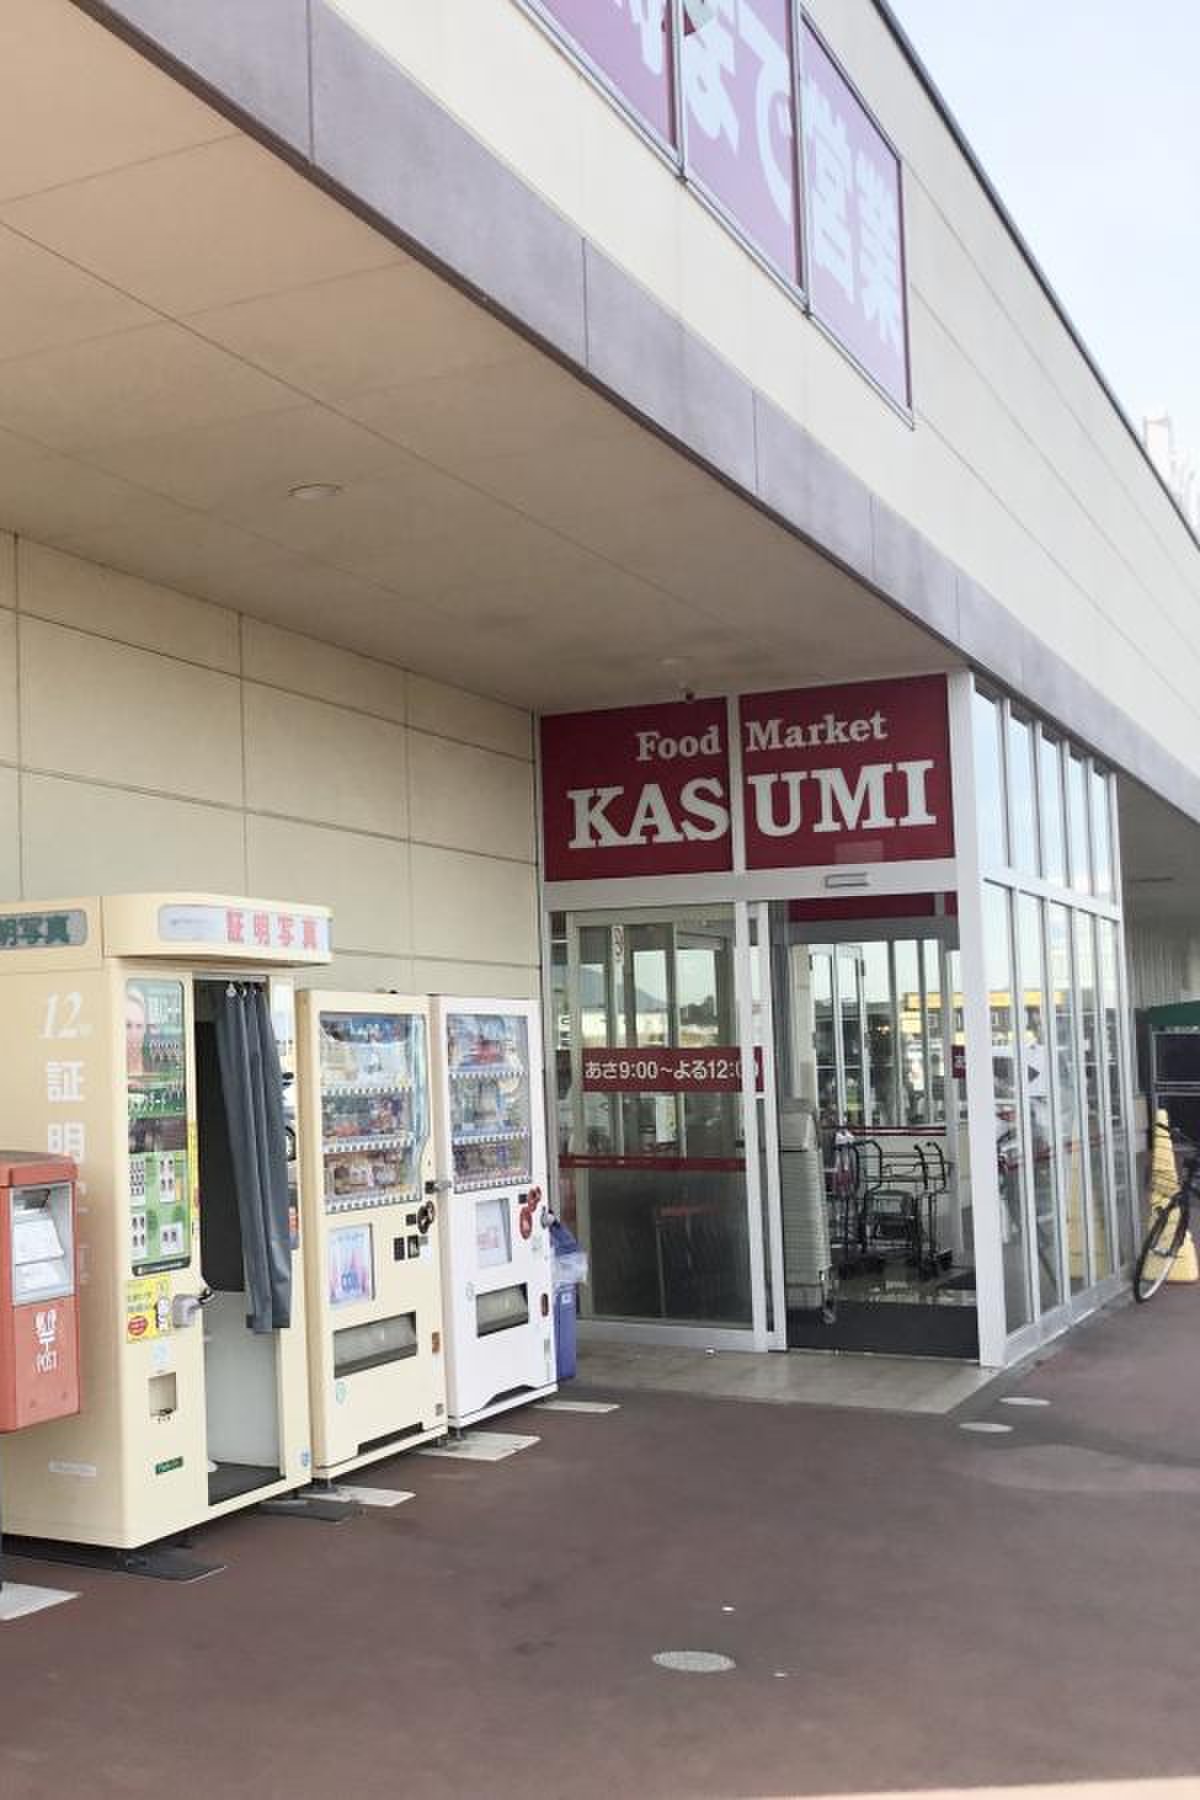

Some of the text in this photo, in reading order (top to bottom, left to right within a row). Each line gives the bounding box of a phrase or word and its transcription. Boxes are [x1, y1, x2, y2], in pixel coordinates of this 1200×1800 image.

[615, 0, 898, 348] まで営業
[636, 709, 889, 762] Food Market
[566, 760, 938, 849] KASUMI
[226, 908, 317, 949] 証明写真
